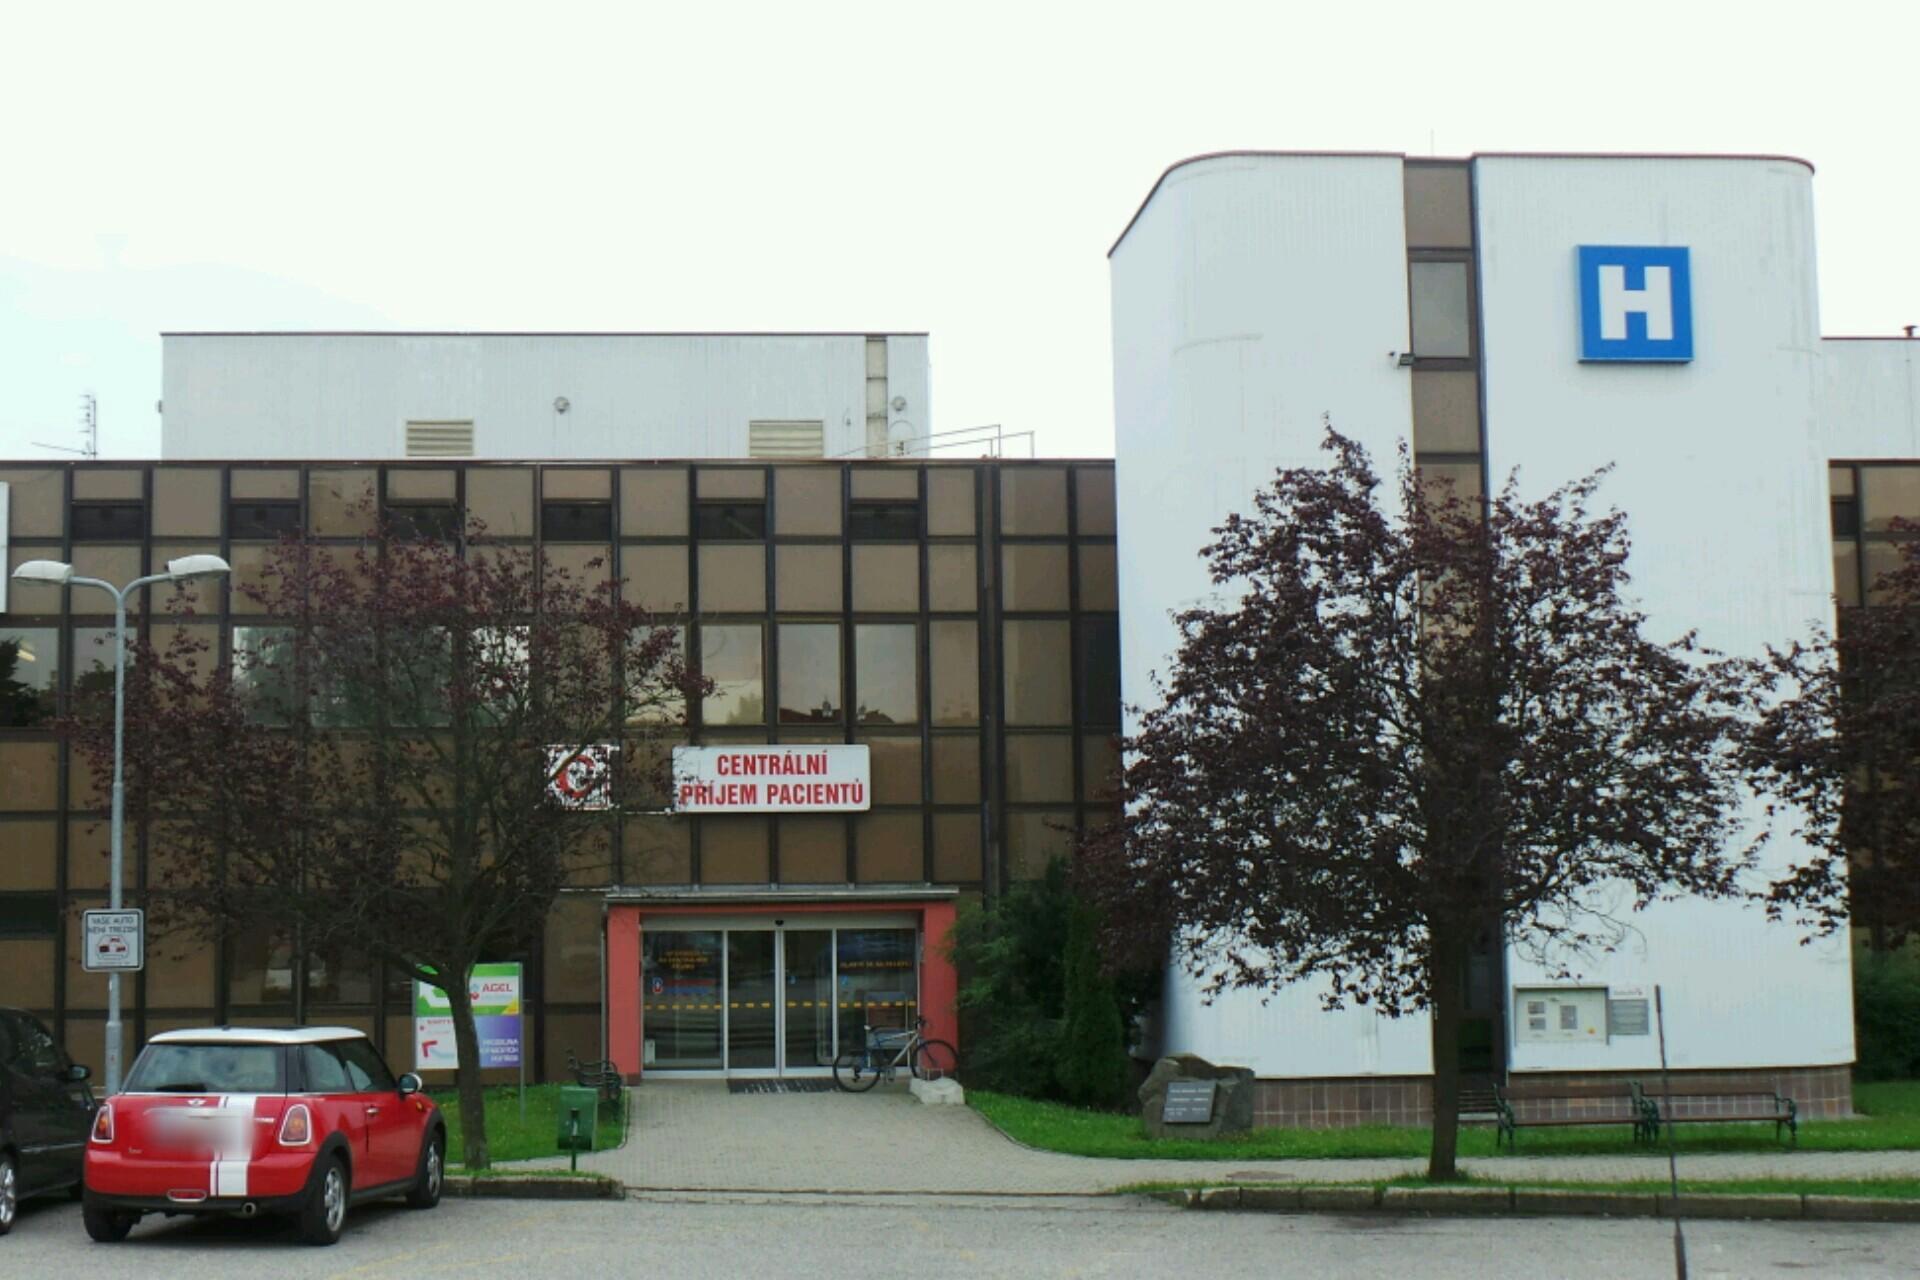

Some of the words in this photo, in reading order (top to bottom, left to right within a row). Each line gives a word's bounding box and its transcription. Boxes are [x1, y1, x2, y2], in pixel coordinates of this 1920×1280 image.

[1598, 265, 1673, 341] H
[717, 750, 828, 776] CENTRÁLNÍ
[680, 780, 757, 805] PŘÍJEM
[767, 778, 864, 805] PACIENTŮ
